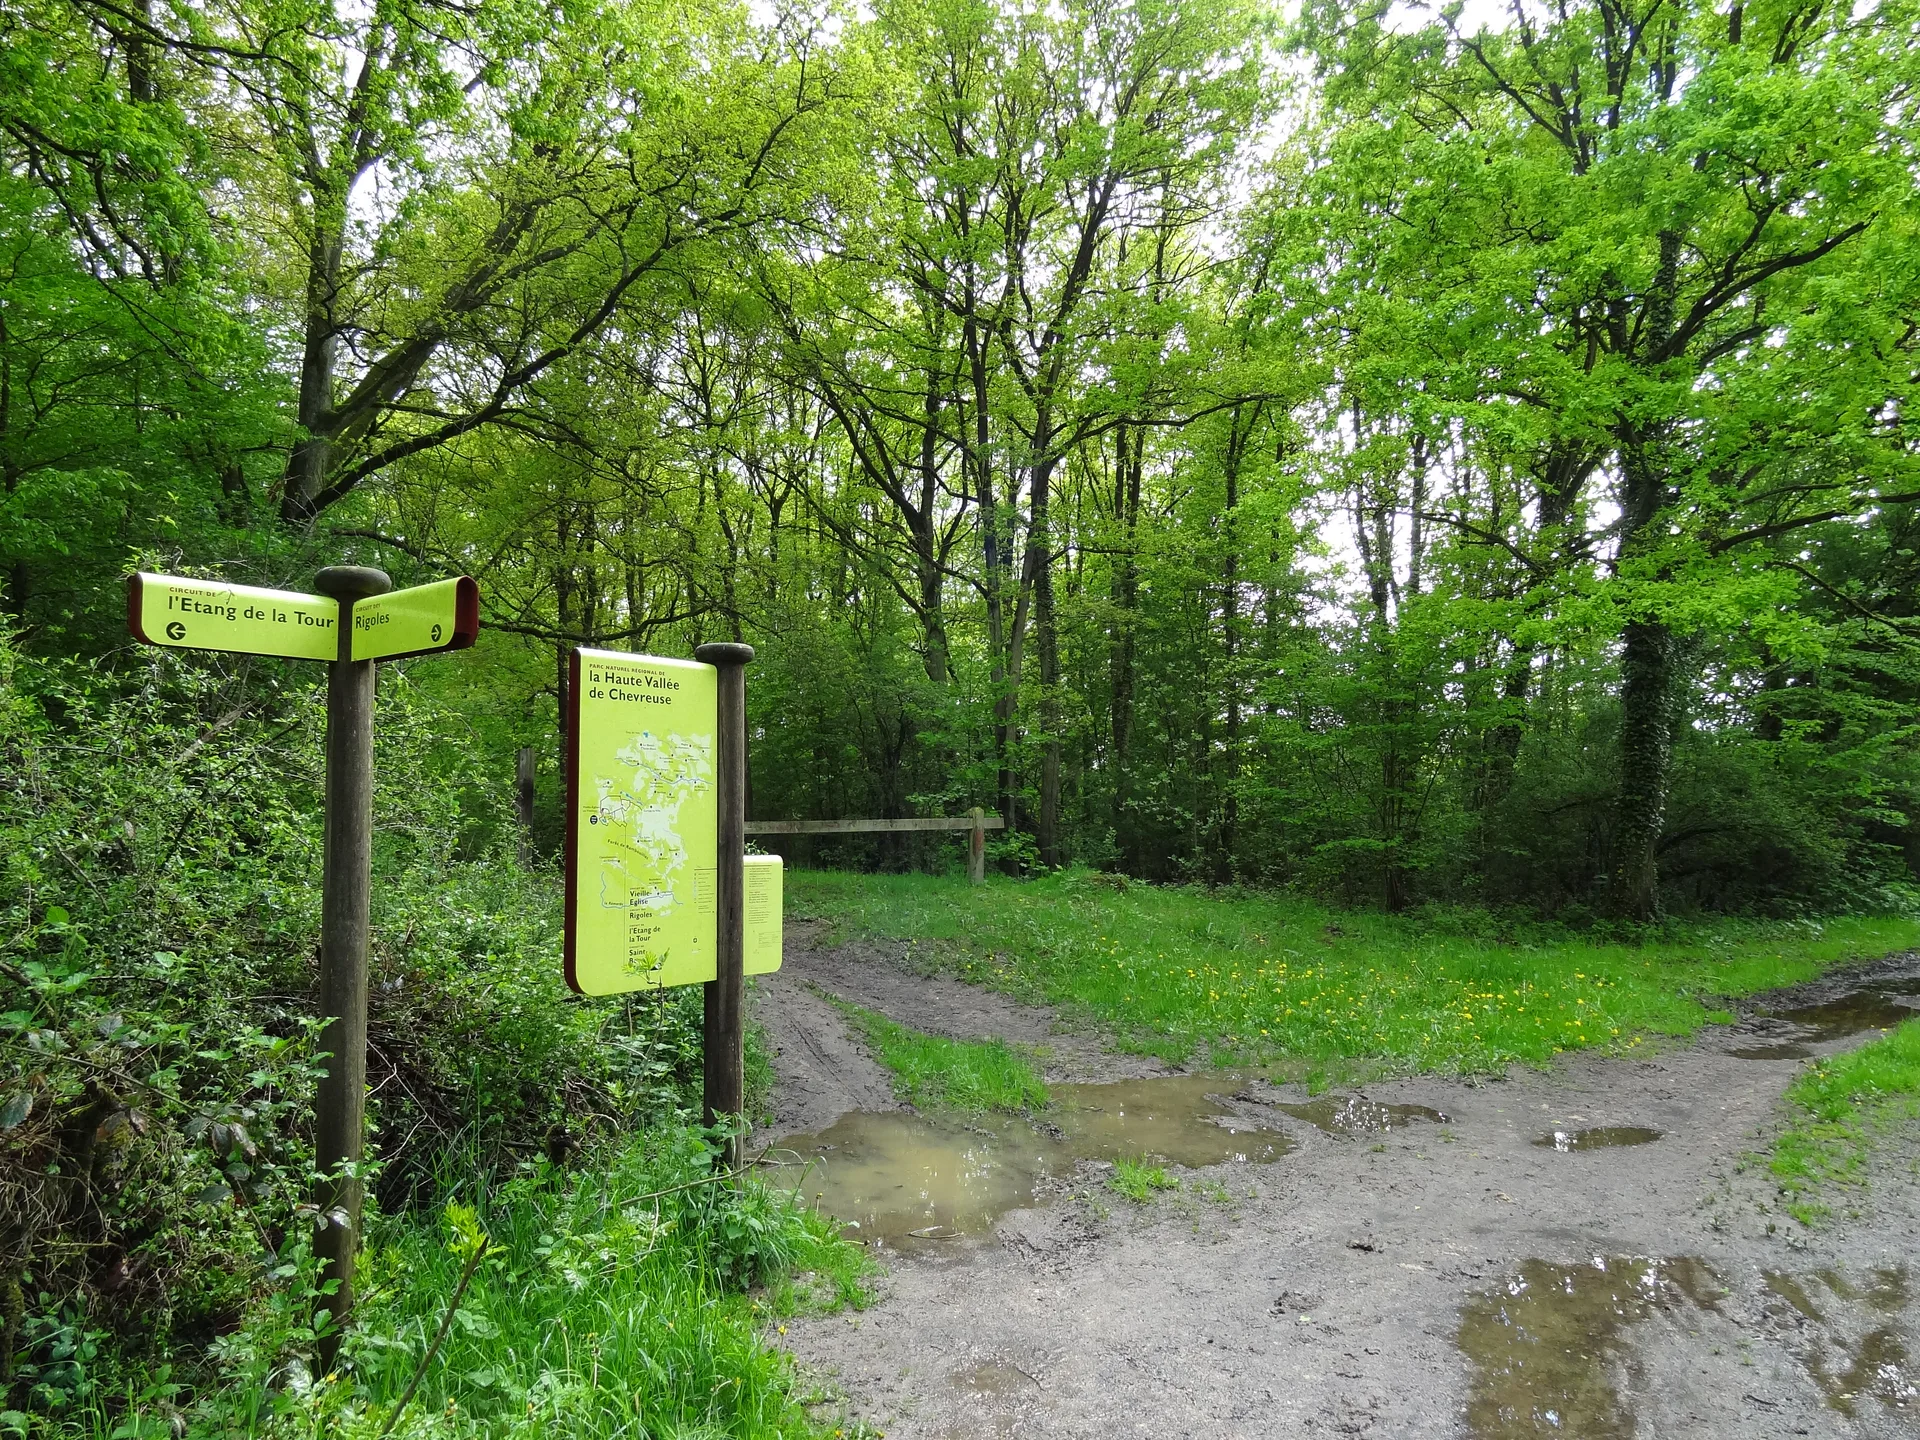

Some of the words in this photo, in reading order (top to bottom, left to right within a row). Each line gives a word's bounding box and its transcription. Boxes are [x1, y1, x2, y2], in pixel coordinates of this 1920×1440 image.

[169, 586, 203, 596] CIRCUIT
[168, 595, 237, 621] l'Etang
[243, 605, 265, 621] de
[272, 608, 287, 623] la
[294, 610, 334, 628] Tour
[355, 604, 372, 613] CIRCUIT
[355, 612, 390, 631] Rigoles
[605, 664, 630, 673] NATUREL
[589, 670, 600, 683] la
[605, 671, 642, 687] Haute
[645, 675, 680, 691] Vallée
[589, 686, 604, 699] de
[609, 688, 672, 705] Chevreuse
[629, 911, 653, 921] Rigoles
[629, 926, 652, 935] l'Etang
[653, 925, 661, 933] de
